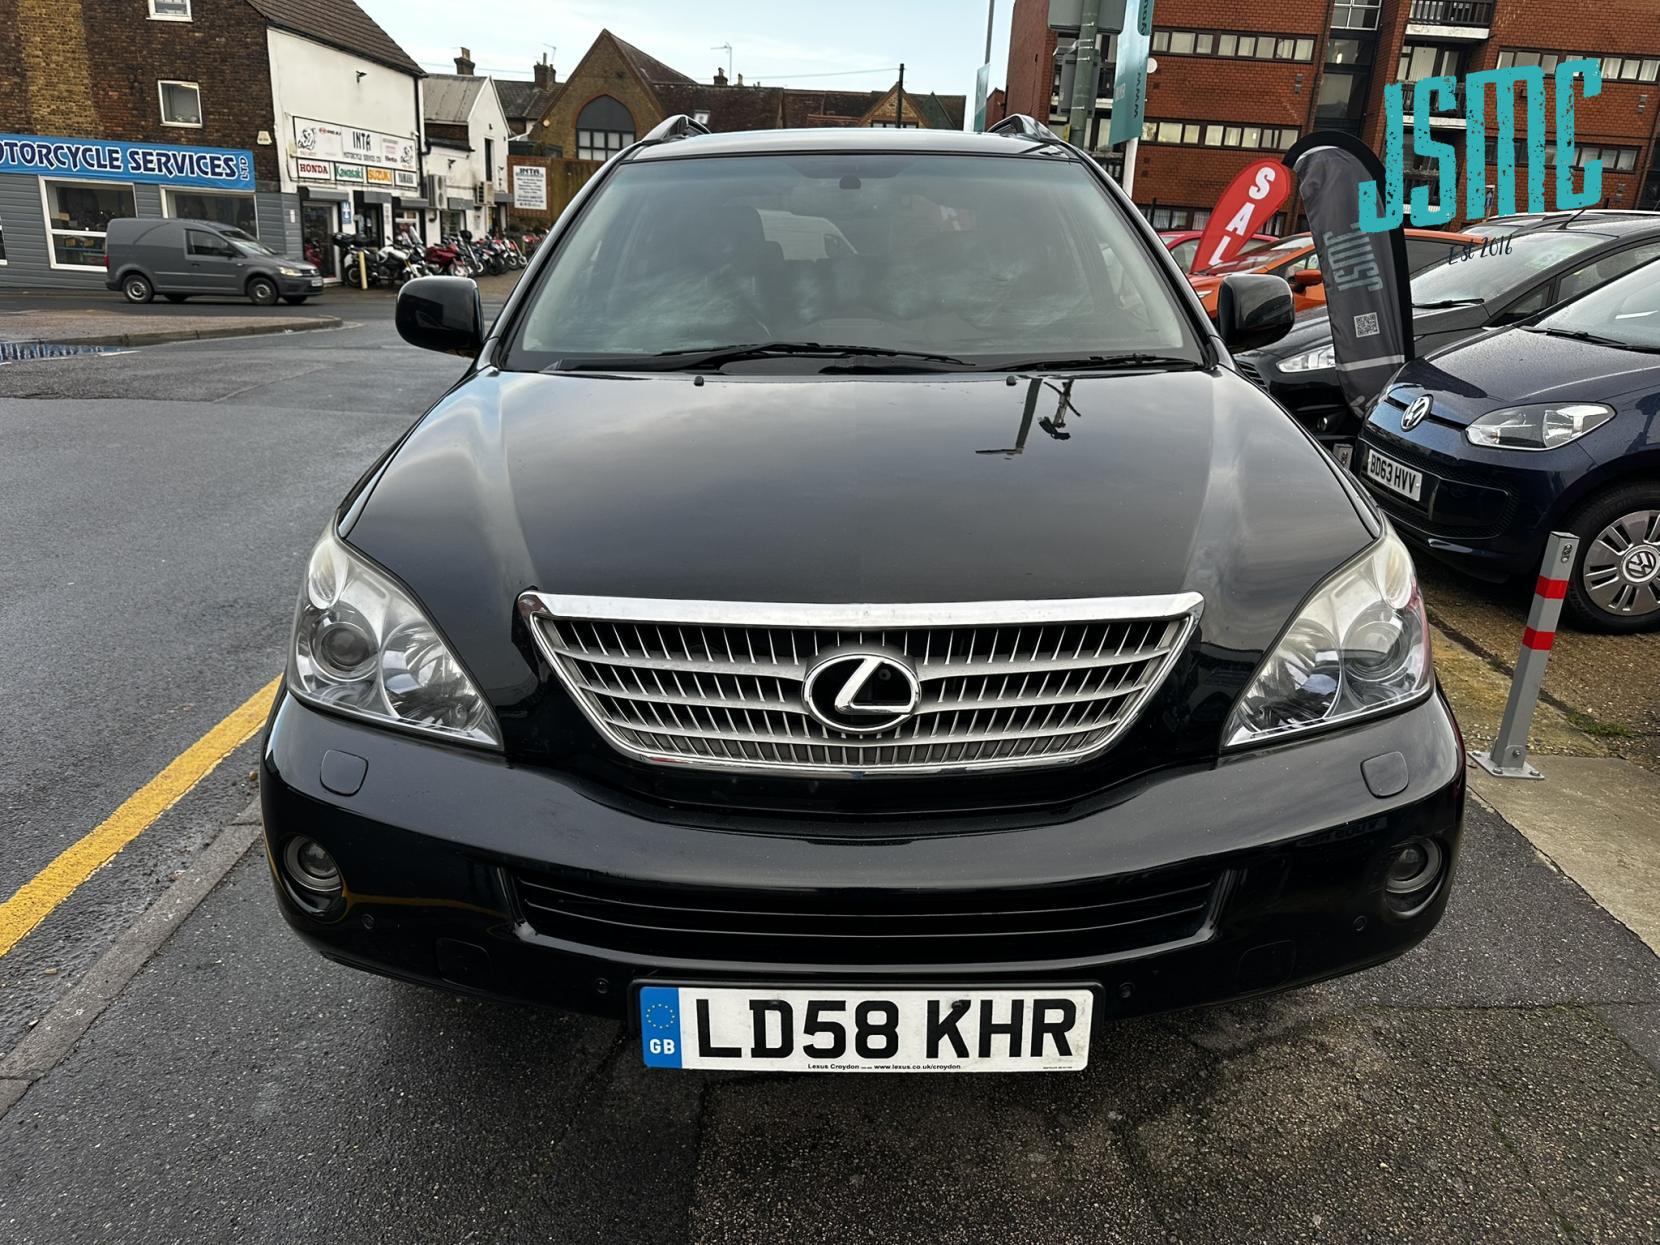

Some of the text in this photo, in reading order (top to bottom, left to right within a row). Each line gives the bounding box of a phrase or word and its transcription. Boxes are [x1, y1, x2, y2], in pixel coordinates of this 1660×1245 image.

[0, 140, 249, 181] TORCYCLE SERVICES LTD
[300, 163, 328, 174] HONDA
[1370, 452, 1416, 494] BD63 HVV
[696, 998, 1077, 1059] LD58 KHR
[649, 1038, 676, 1055] GB
[830, 1063, 859, 1071] Croydon
